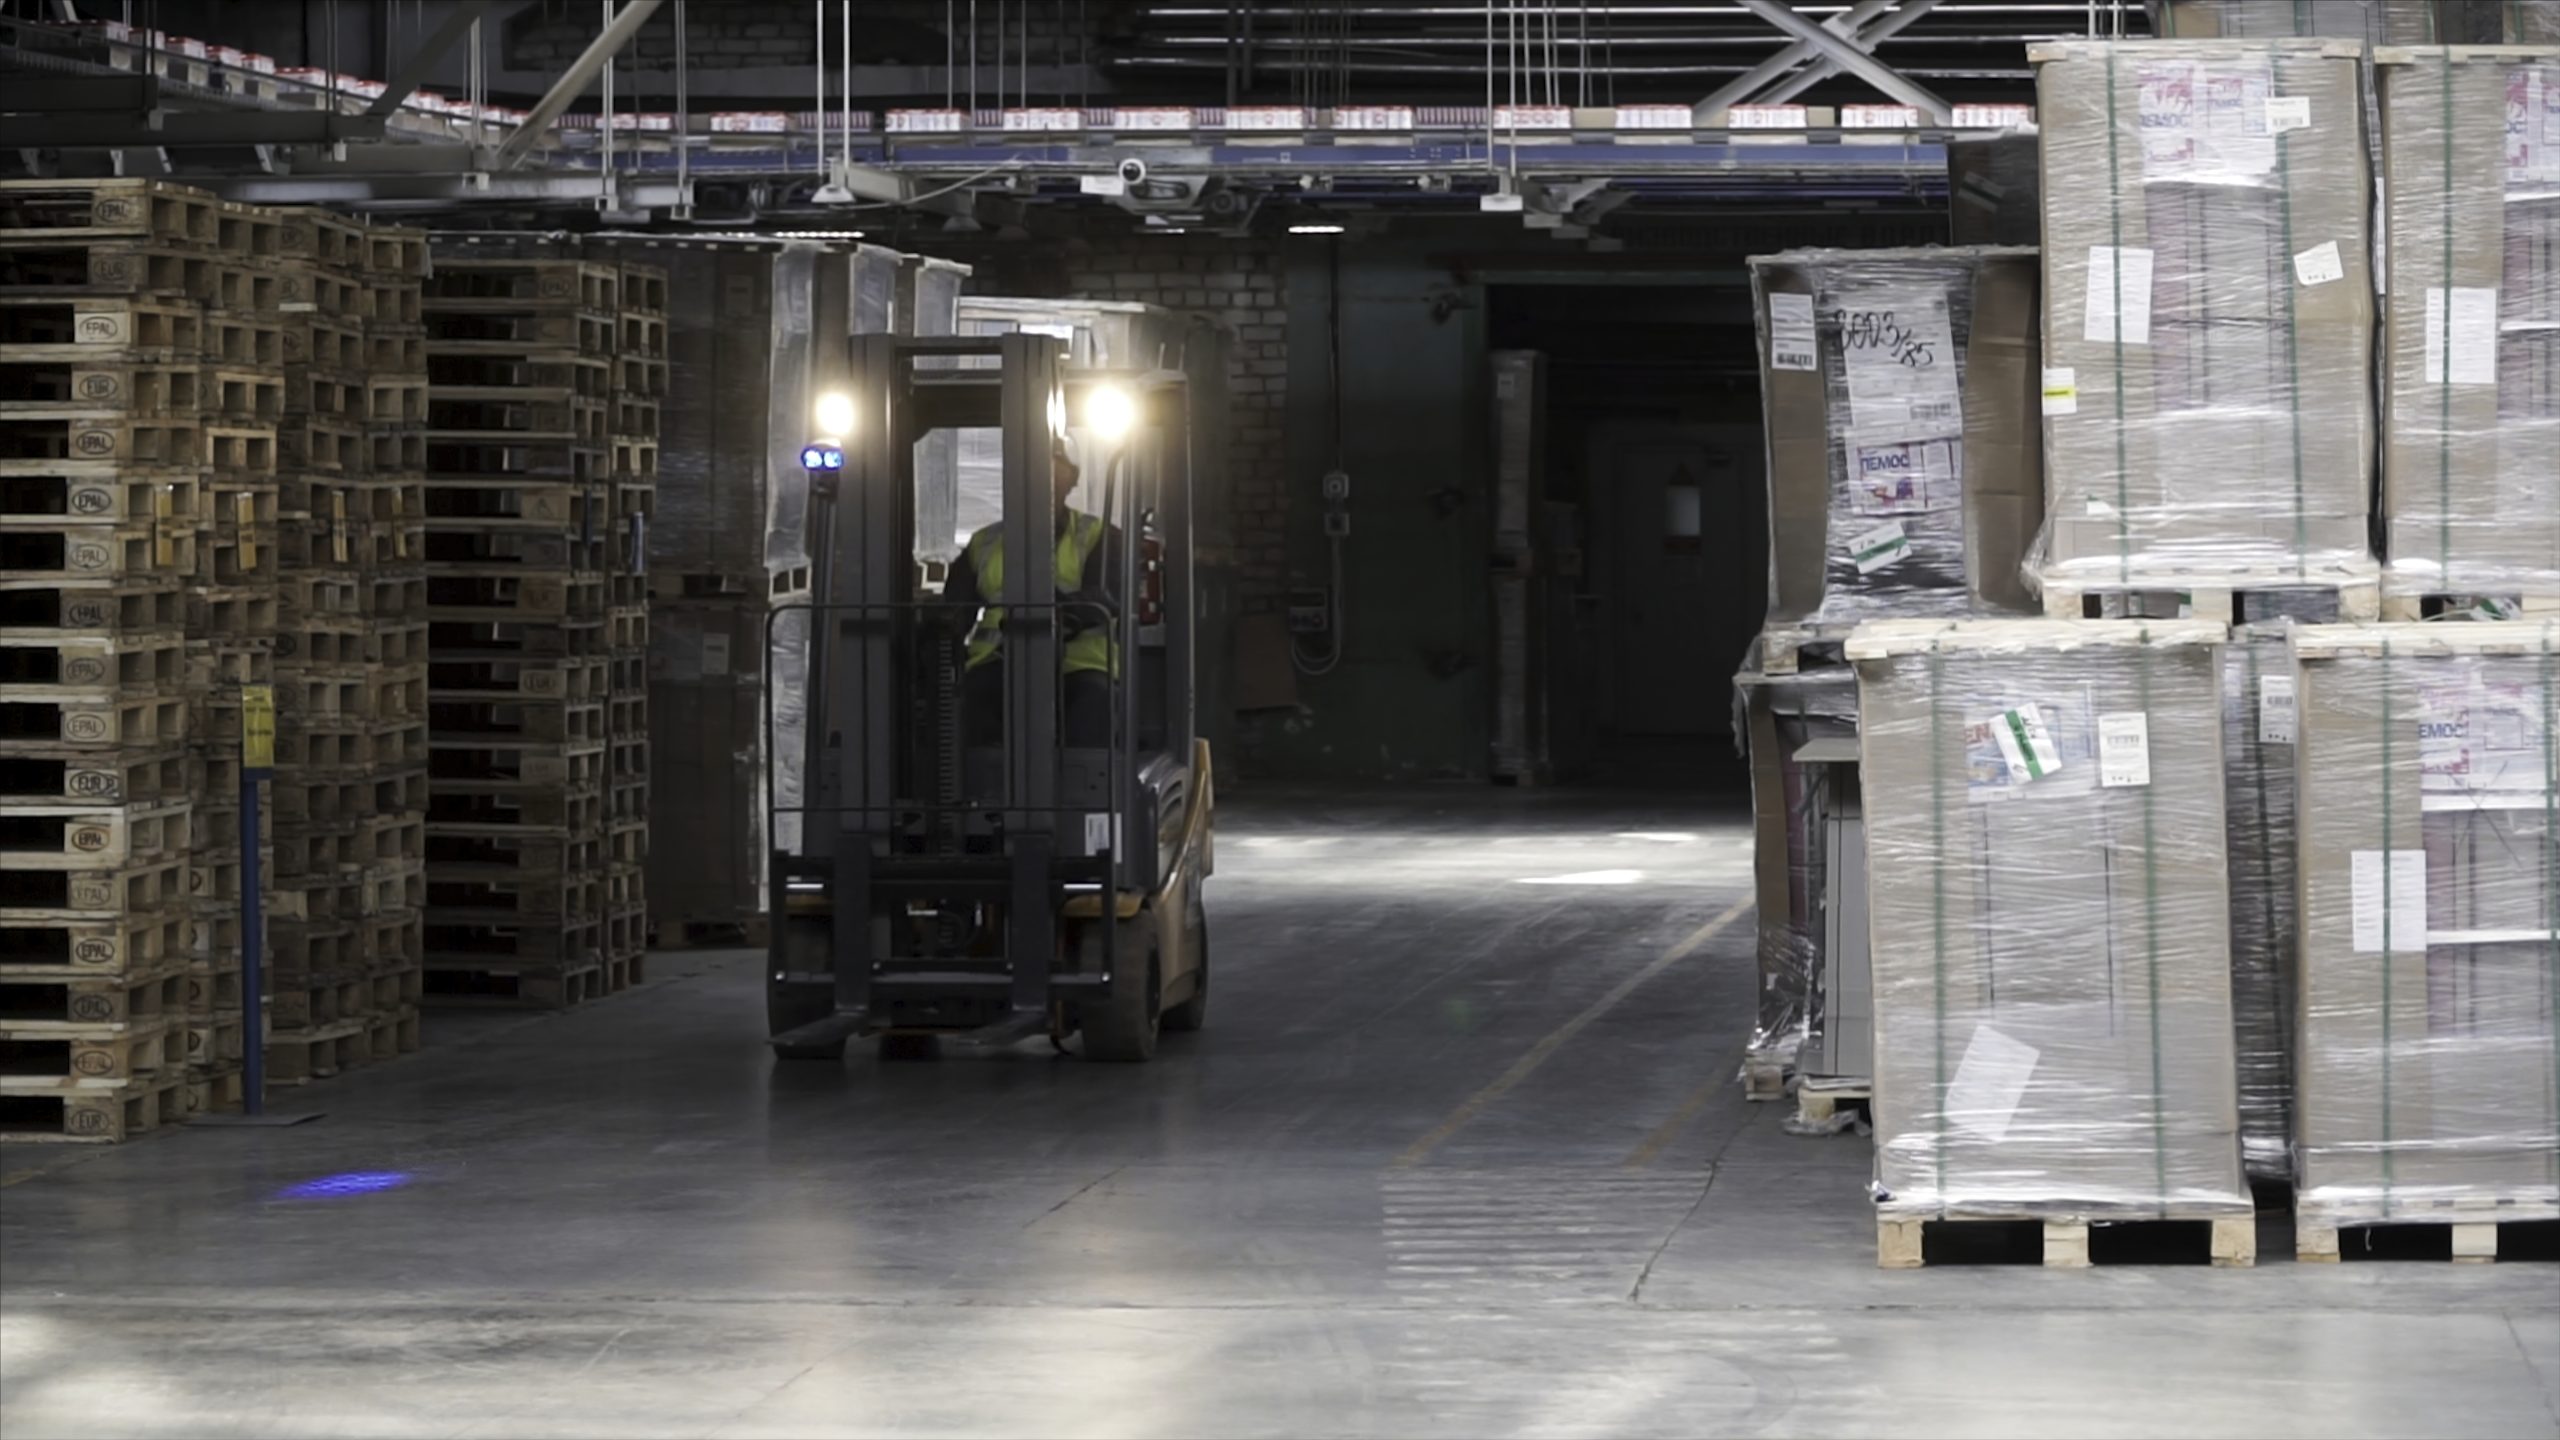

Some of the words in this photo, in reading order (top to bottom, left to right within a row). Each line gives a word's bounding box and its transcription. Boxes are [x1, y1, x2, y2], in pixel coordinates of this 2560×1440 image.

[79, 494, 103, 508] EPAL
[76, 548, 101, 561] EPAL
[73, 720, 98, 733] EPAL
[2418, 723, 2465, 738] ЕМОС
[82, 943, 107, 956] EPAL
[79, 1114, 101, 1127] EUR
